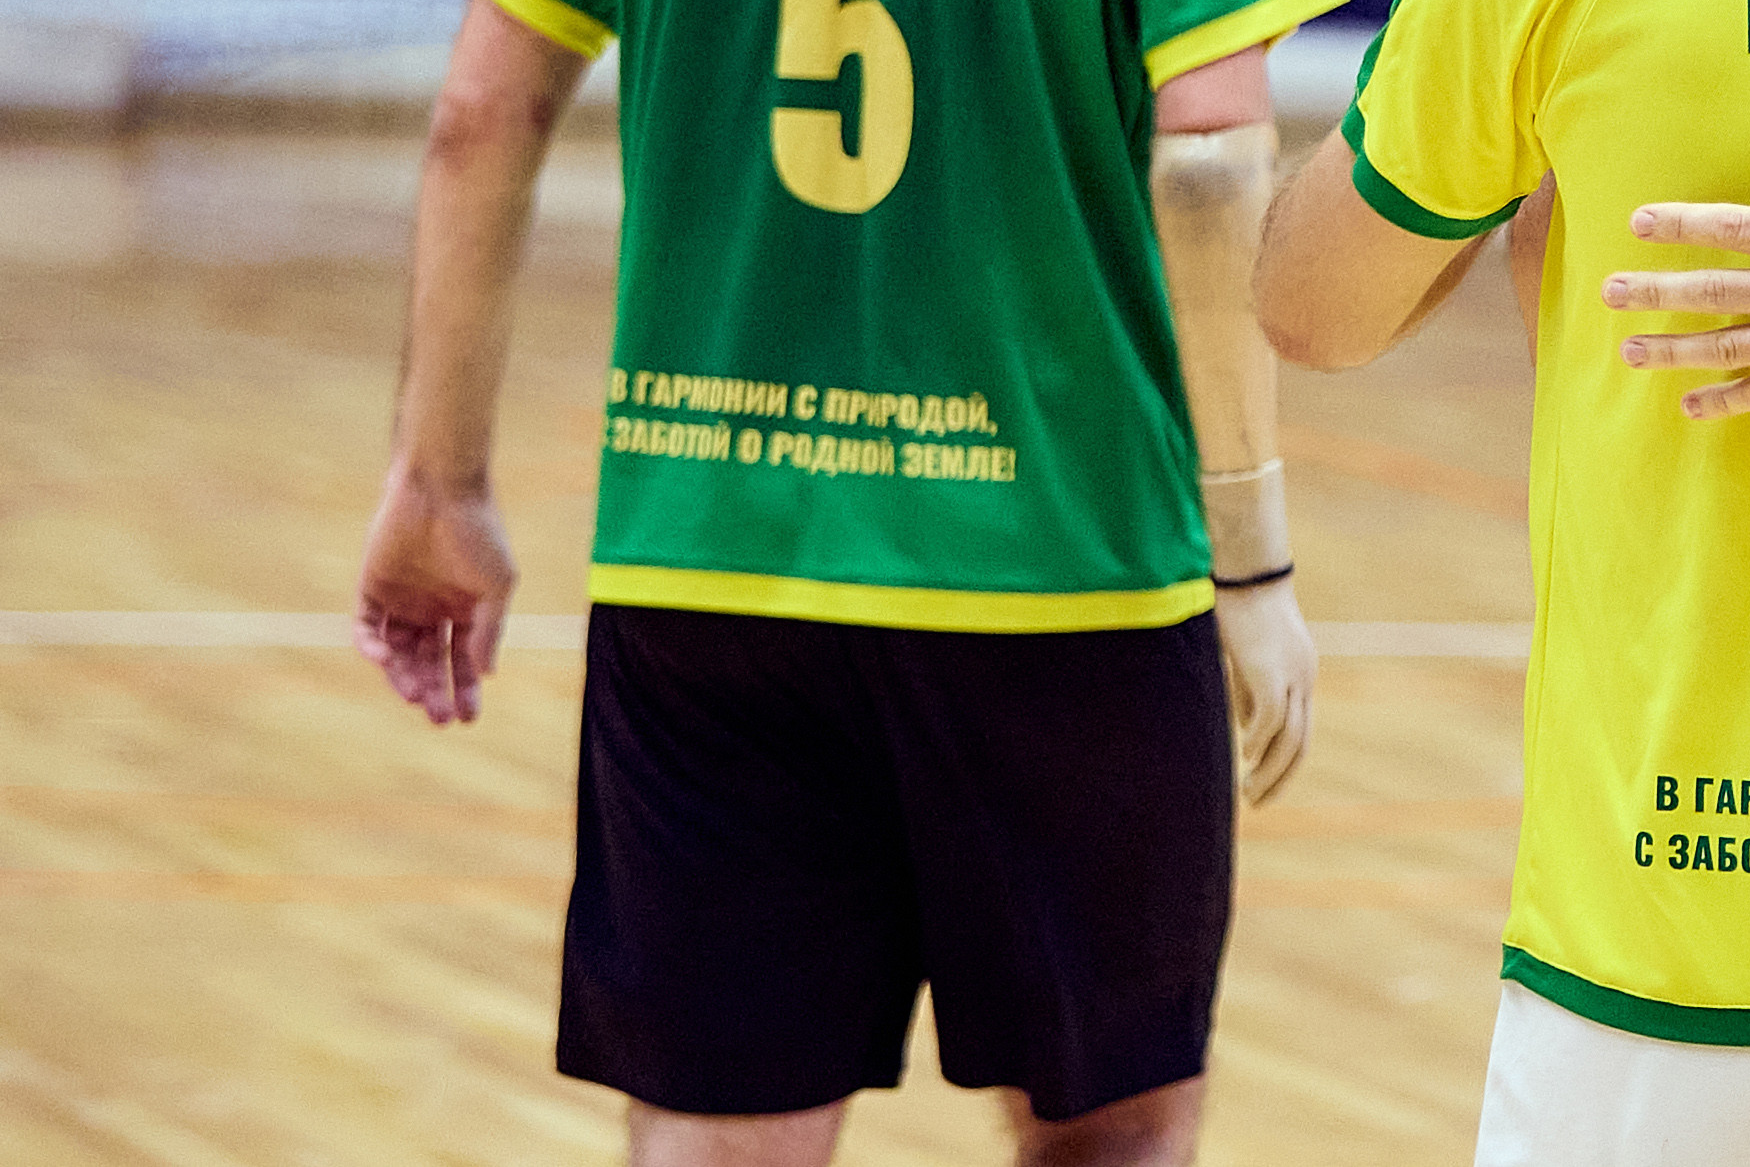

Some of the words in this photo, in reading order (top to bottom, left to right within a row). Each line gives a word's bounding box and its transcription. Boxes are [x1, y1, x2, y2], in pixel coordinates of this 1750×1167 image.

[607, 367, 628, 404] В
[632, 370, 789, 418] ГАРМОНИИ
[793, 384, 818, 421] С
[822, 387, 998, 437] ПРИРОДОЙ,
[611, 416, 731, 461] ЗАБОТОЙ
[736, 428, 763, 465] О
[767, 431, 895, 478] РОДНОЙ
[1655, 775, 1679, 812] В
[1634, 831, 1654, 868] С
